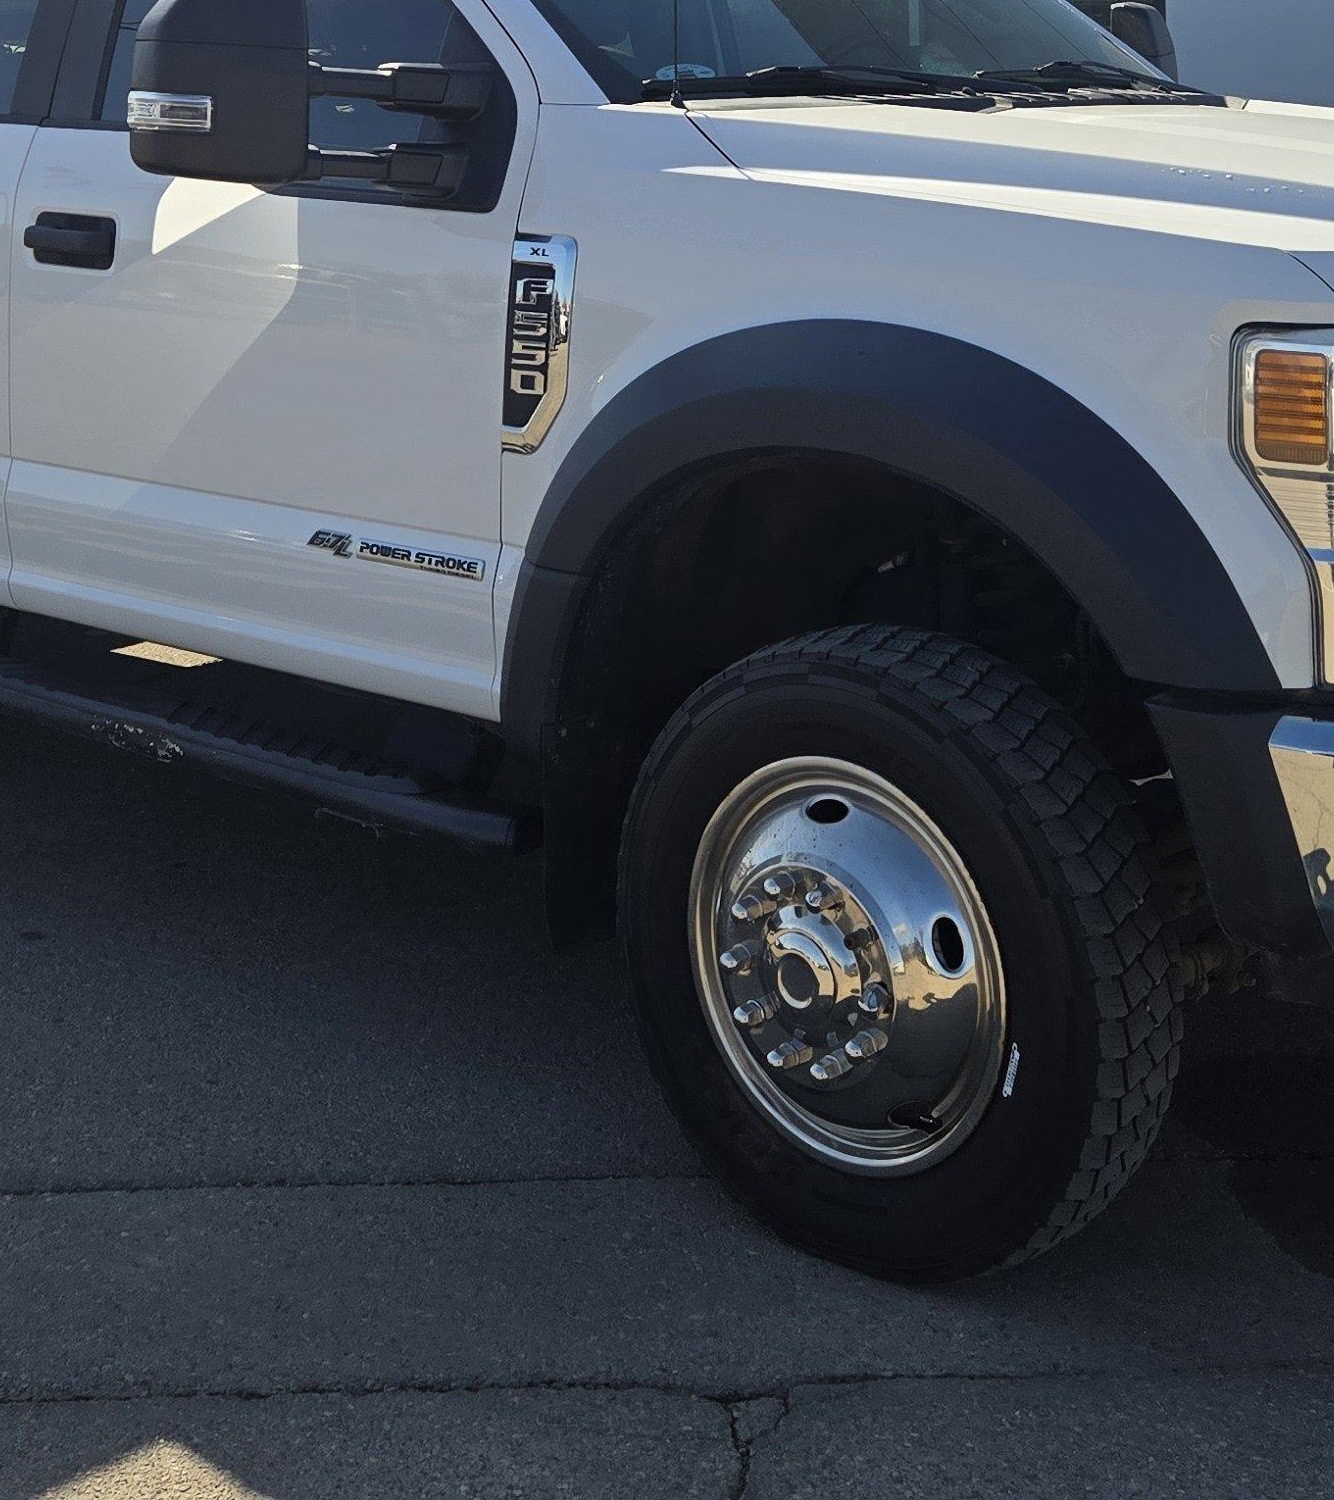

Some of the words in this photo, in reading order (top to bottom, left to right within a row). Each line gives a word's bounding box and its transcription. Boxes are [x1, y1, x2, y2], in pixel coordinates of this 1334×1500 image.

[529, 246, 550, 258] XL
[359, 541, 412, 562] POWER
[414, 551, 479, 575] STROKE
